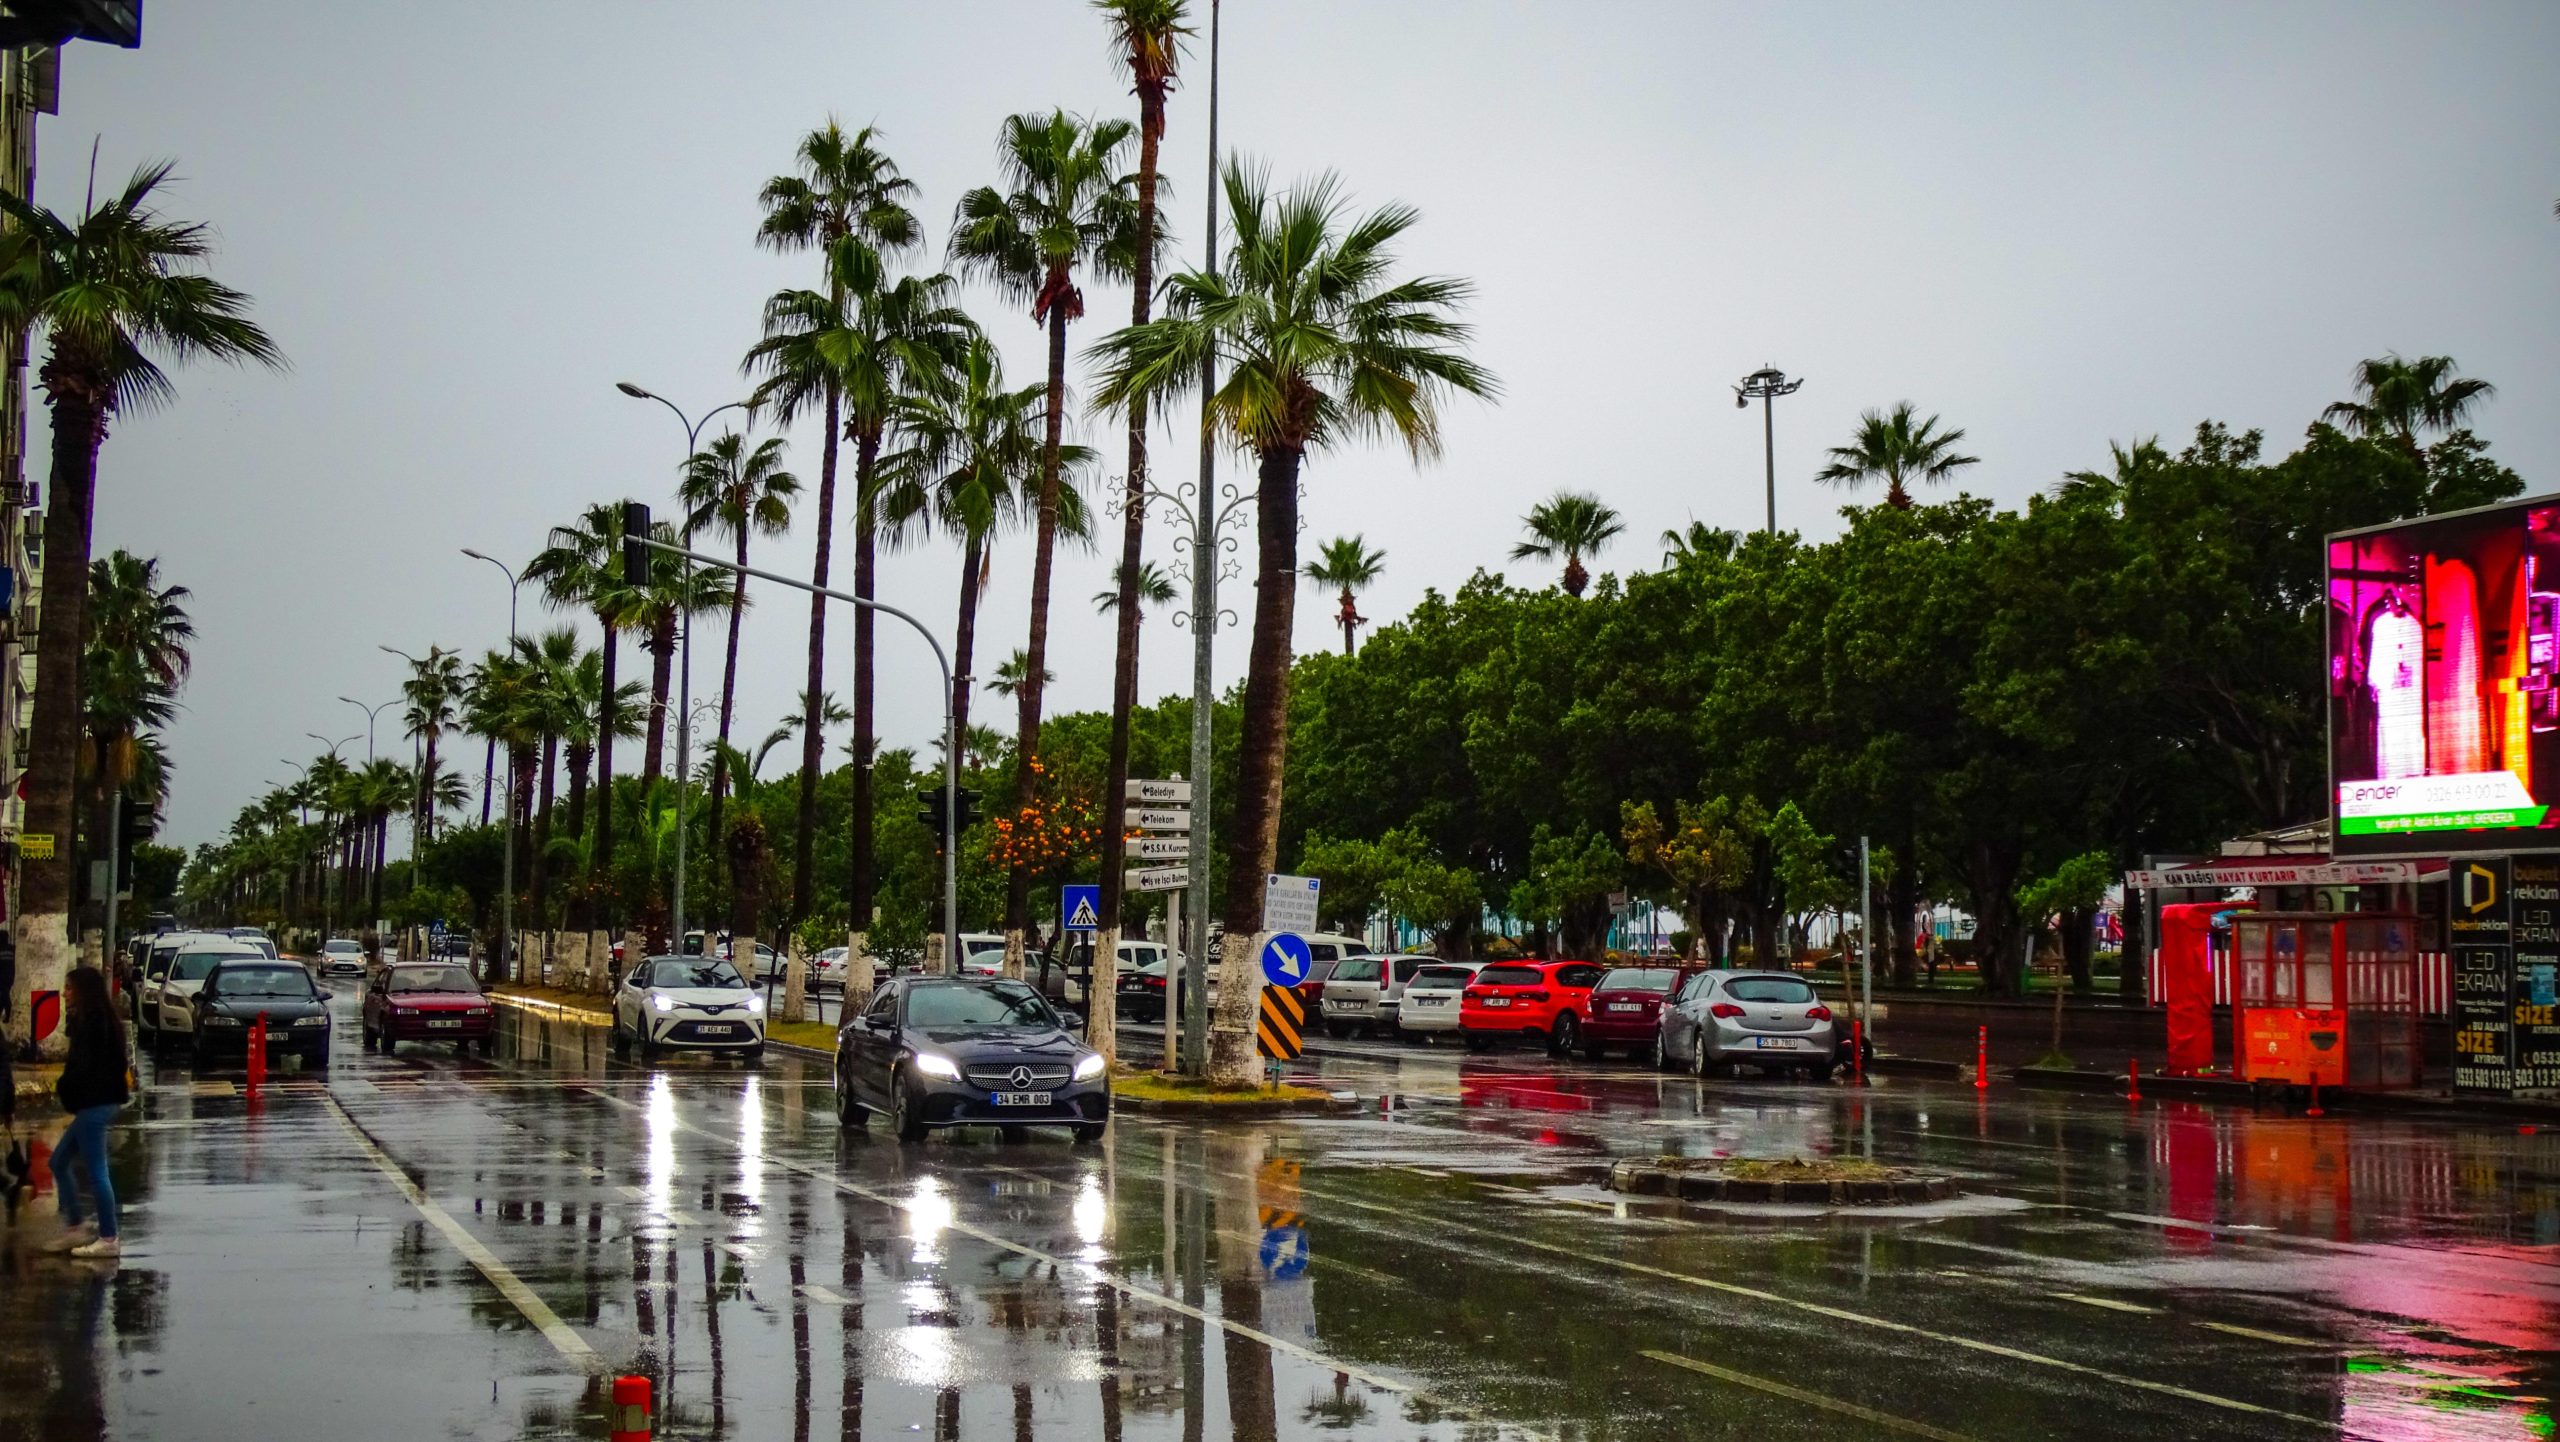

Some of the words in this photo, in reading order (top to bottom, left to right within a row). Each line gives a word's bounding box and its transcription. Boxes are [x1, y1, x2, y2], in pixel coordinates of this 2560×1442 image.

[1150, 787, 1175, 799] Belediye
[1150, 814, 1175, 824] Telekom
[1172, 873, 1188, 883] Bulma
[2164, 873, 2183, 885] KAN
[2185, 870, 2215, 885] BAĞIŞI
[2216, 872, 2245, 884] HAYAT
[2249, 870, 2297, 883] KURTARIR
[2513, 884, 2559, 900] reklam
[2523, 910, 2550, 925] LED
[2466, 952, 2495, 971] LED
[2456, 972, 2506, 992] EKRAN
[2472, 1021, 2483, 1031] BU
[2484, 1022, 2508, 1032] ALANI
[2456, 1024, 2494, 1053] SİZE
[2473, 1054, 2505, 1065] AYIRDIK
[2456, 1067, 2474, 1087] 0533
[2475, 1068, 2489, 1088] 503
[2490, 1069, 2500, 1089] 13
[2515, 1068, 2534, 1088] 503
[2536, 1069, 2548, 1087] 13
[998, 1094, 1009, 1104] 34
[1012, 1094, 1030, 1104] EMR
[1033, 1094, 1050, 1104] 003
